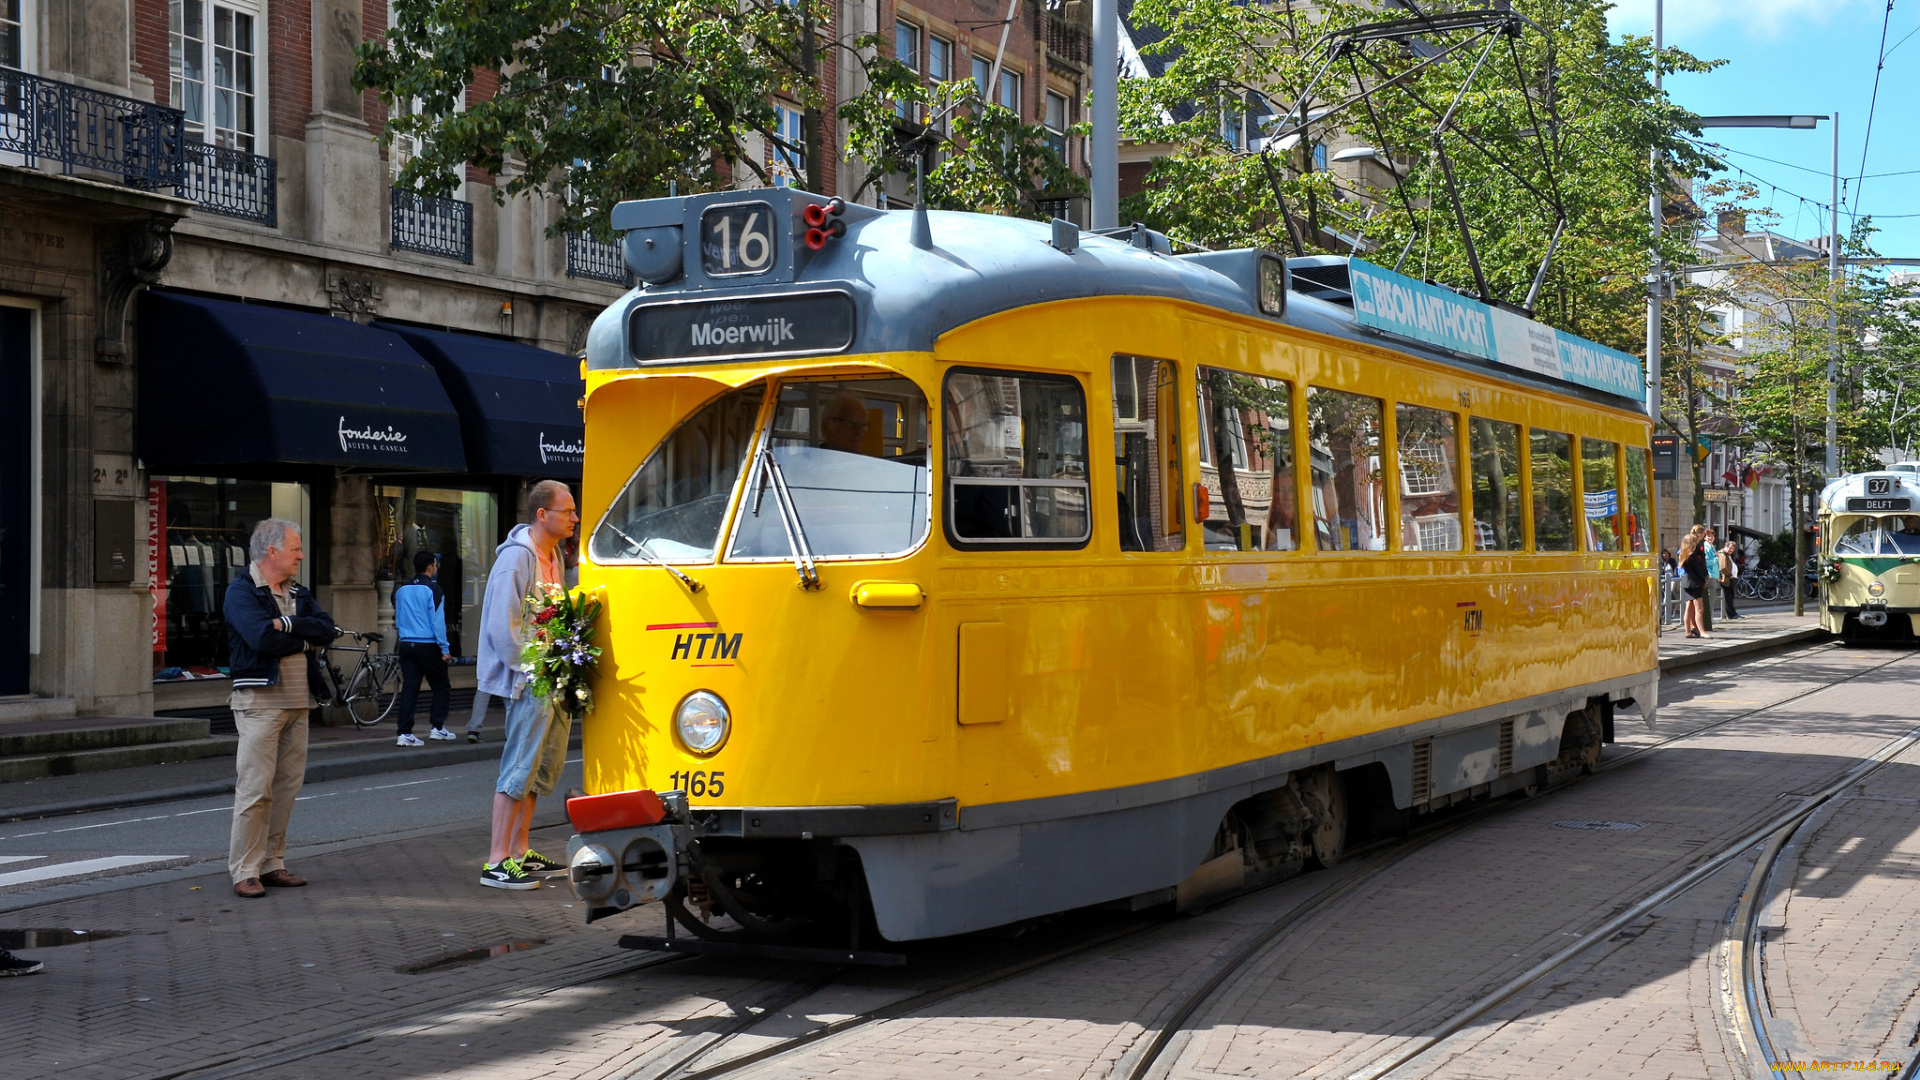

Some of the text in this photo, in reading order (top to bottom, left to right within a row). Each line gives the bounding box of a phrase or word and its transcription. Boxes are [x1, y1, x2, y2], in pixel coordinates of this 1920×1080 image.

[23, 231, 65, 249] TWEE
[713, 212, 770, 268] 16
[1371, 276, 1489, 349] BISON ANTI-VOCHT
[691, 317, 795, 346] Moerwijk
[1570, 342, 1598, 380] BISON
[338, 416, 407, 453] fonderie
[348, 442, 370, 450] SUITS
[380, 444, 408, 453] CASUAL
[539, 431, 585, 465] fonderi
[1870, 480, 1888, 492] 37
[1866, 500, 1893, 509] DELFT
[1464, 610, 1483, 632] HTM
[671, 633, 743, 660] HTM
[670, 771, 725, 798] 1165
